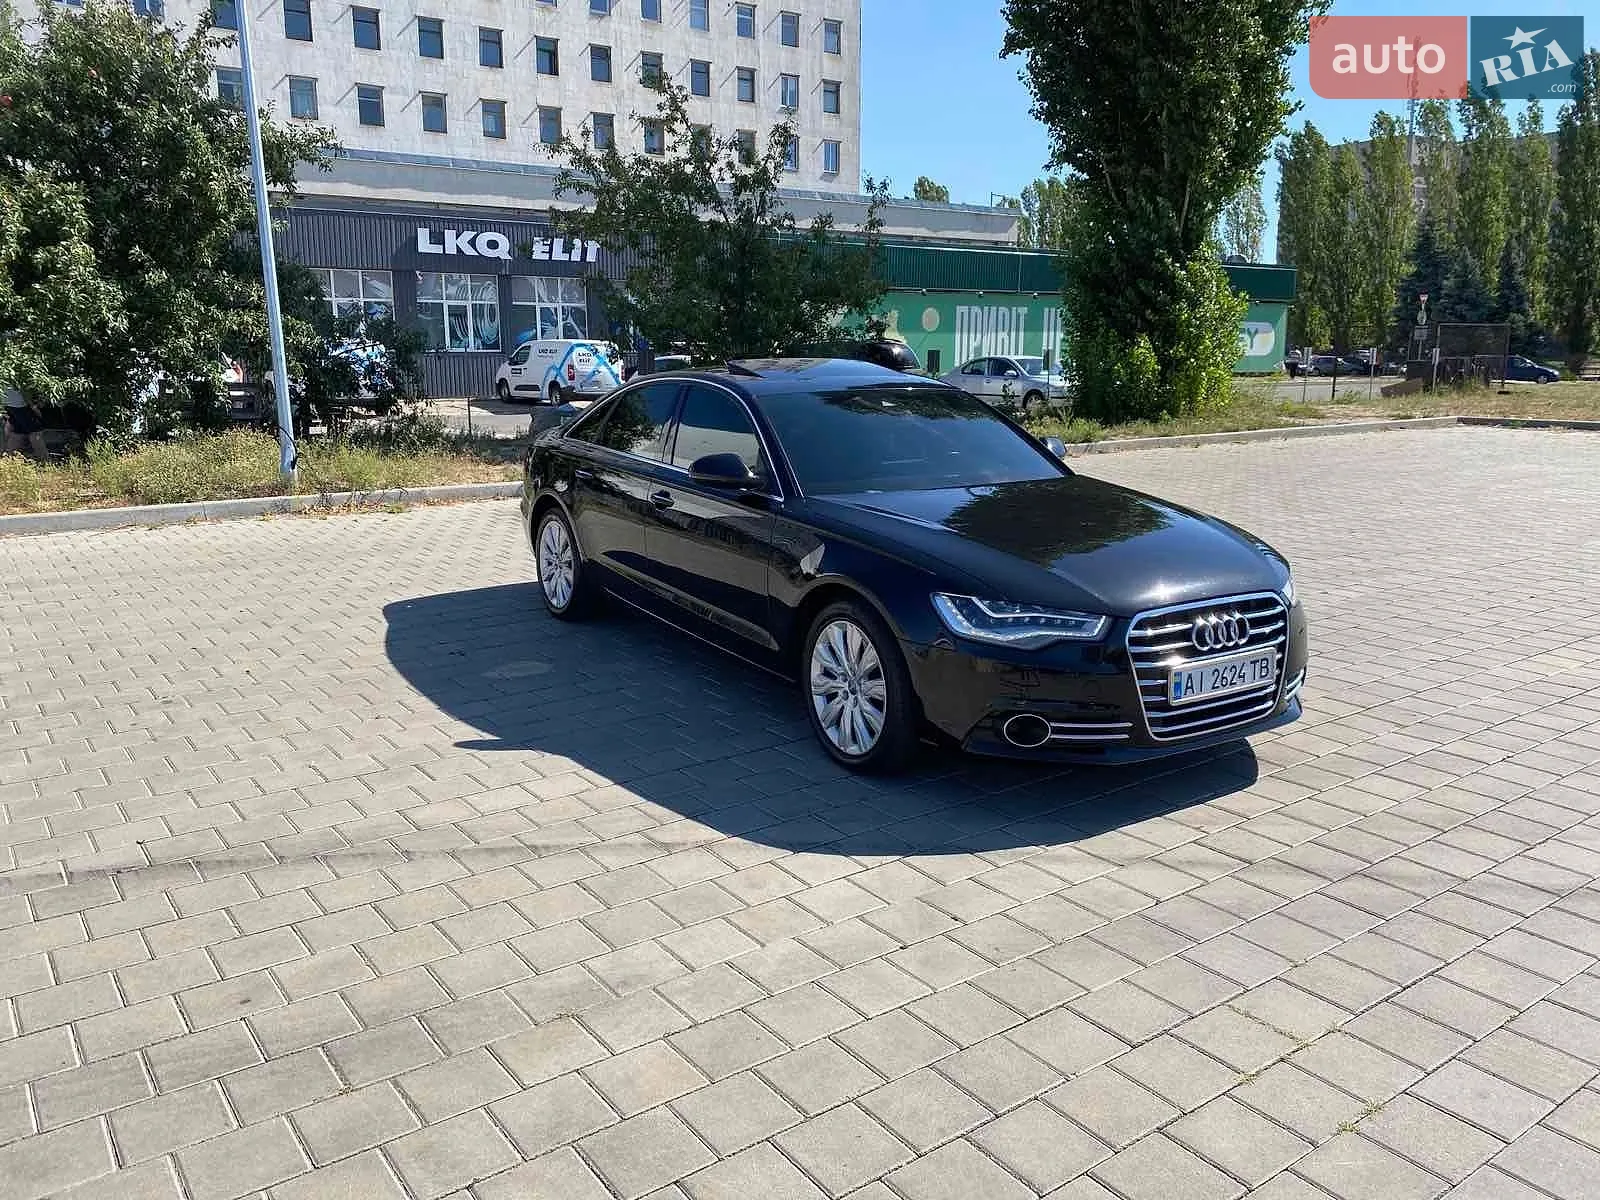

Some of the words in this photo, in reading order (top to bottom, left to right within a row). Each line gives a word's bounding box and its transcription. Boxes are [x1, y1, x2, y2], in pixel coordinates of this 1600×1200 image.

[417, 227, 512, 260] LKQ
[532, 236, 600, 262] ELIT
[1184, 671, 1204, 695] AI
[1211, 662, 1246, 690] 2624
[1250, 657, 1269, 680] TB
